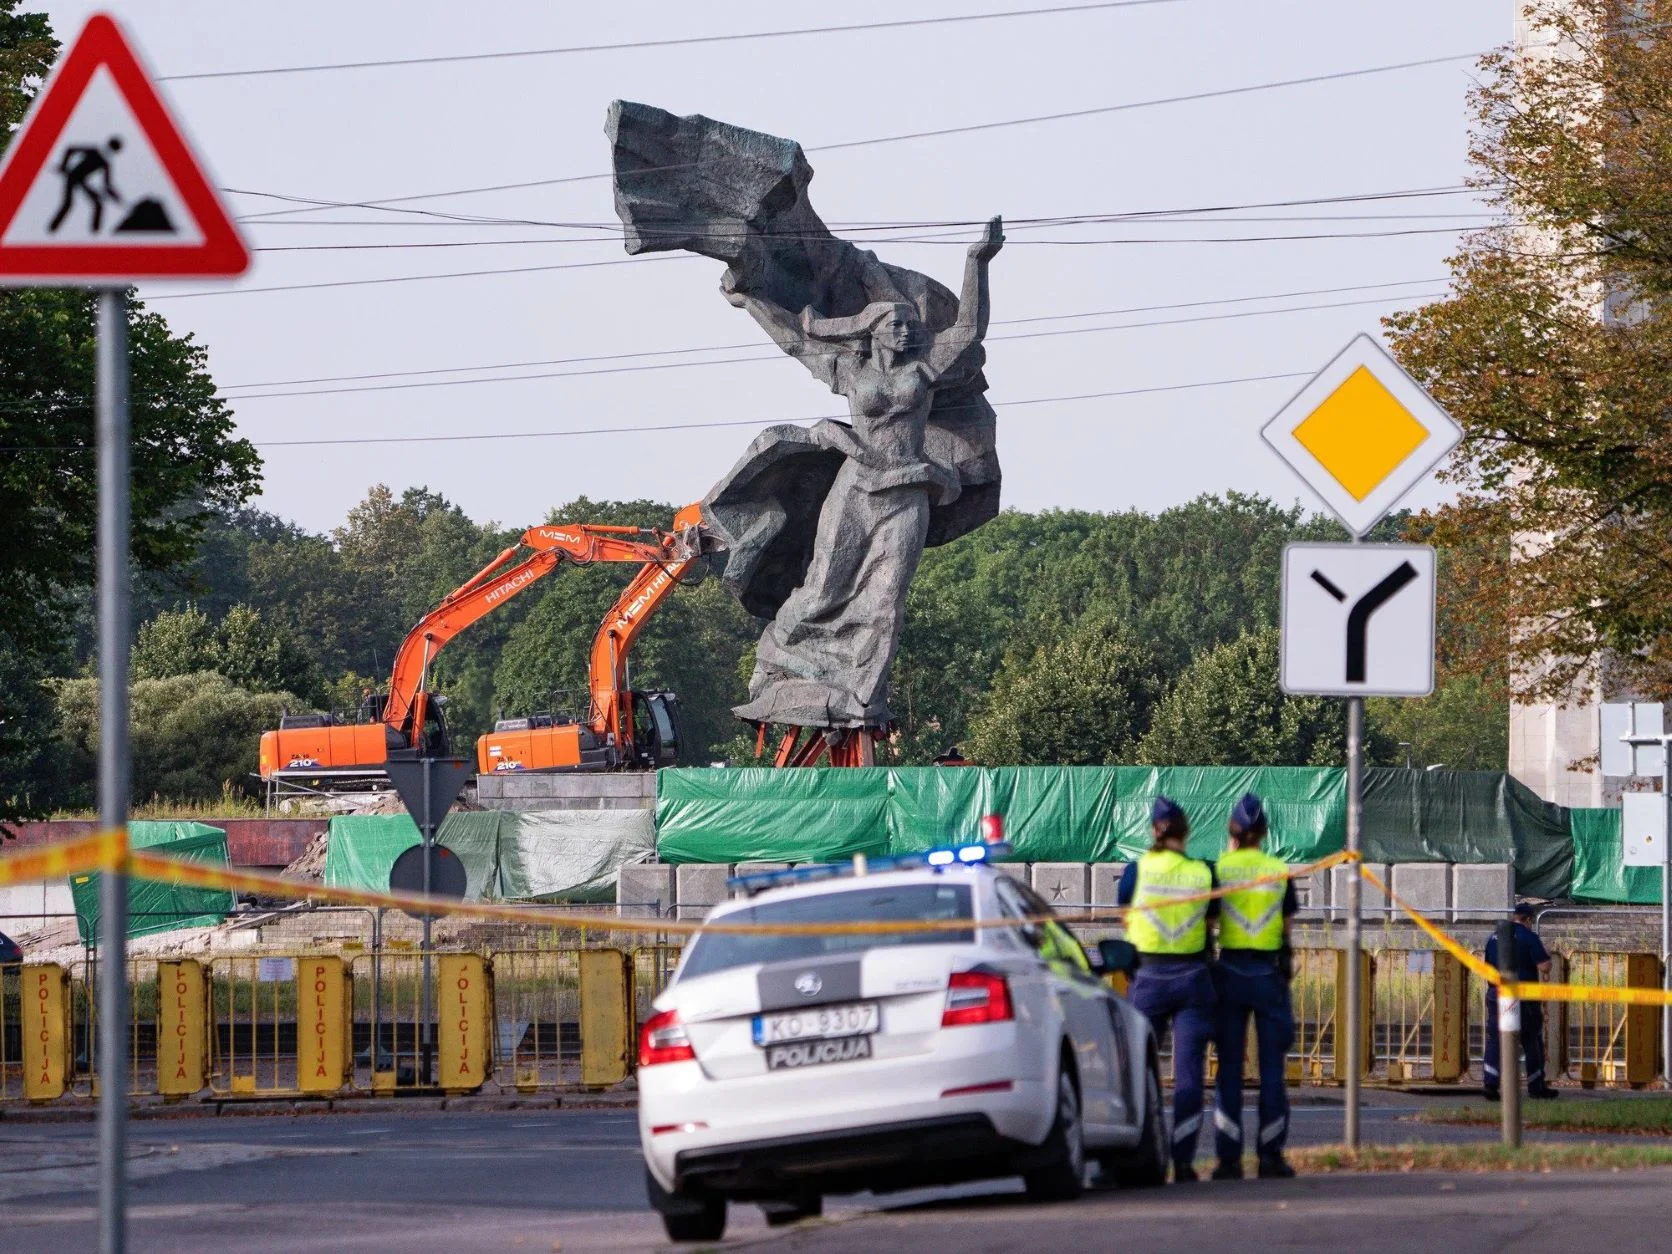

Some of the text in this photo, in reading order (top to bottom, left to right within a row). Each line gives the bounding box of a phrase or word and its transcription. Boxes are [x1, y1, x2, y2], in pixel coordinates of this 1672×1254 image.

[485, 568, 535, 604] HITACHI
[289, 759, 313, 768] 210
[496, 761, 517, 771] 210
[38, 973, 51, 1085] POLICIJA
[314, 966, 328, 1078] POLICIJA
[456, 964, 471, 1075] OLICIJA
[770, 1036, 871, 1069] POLICIJA
